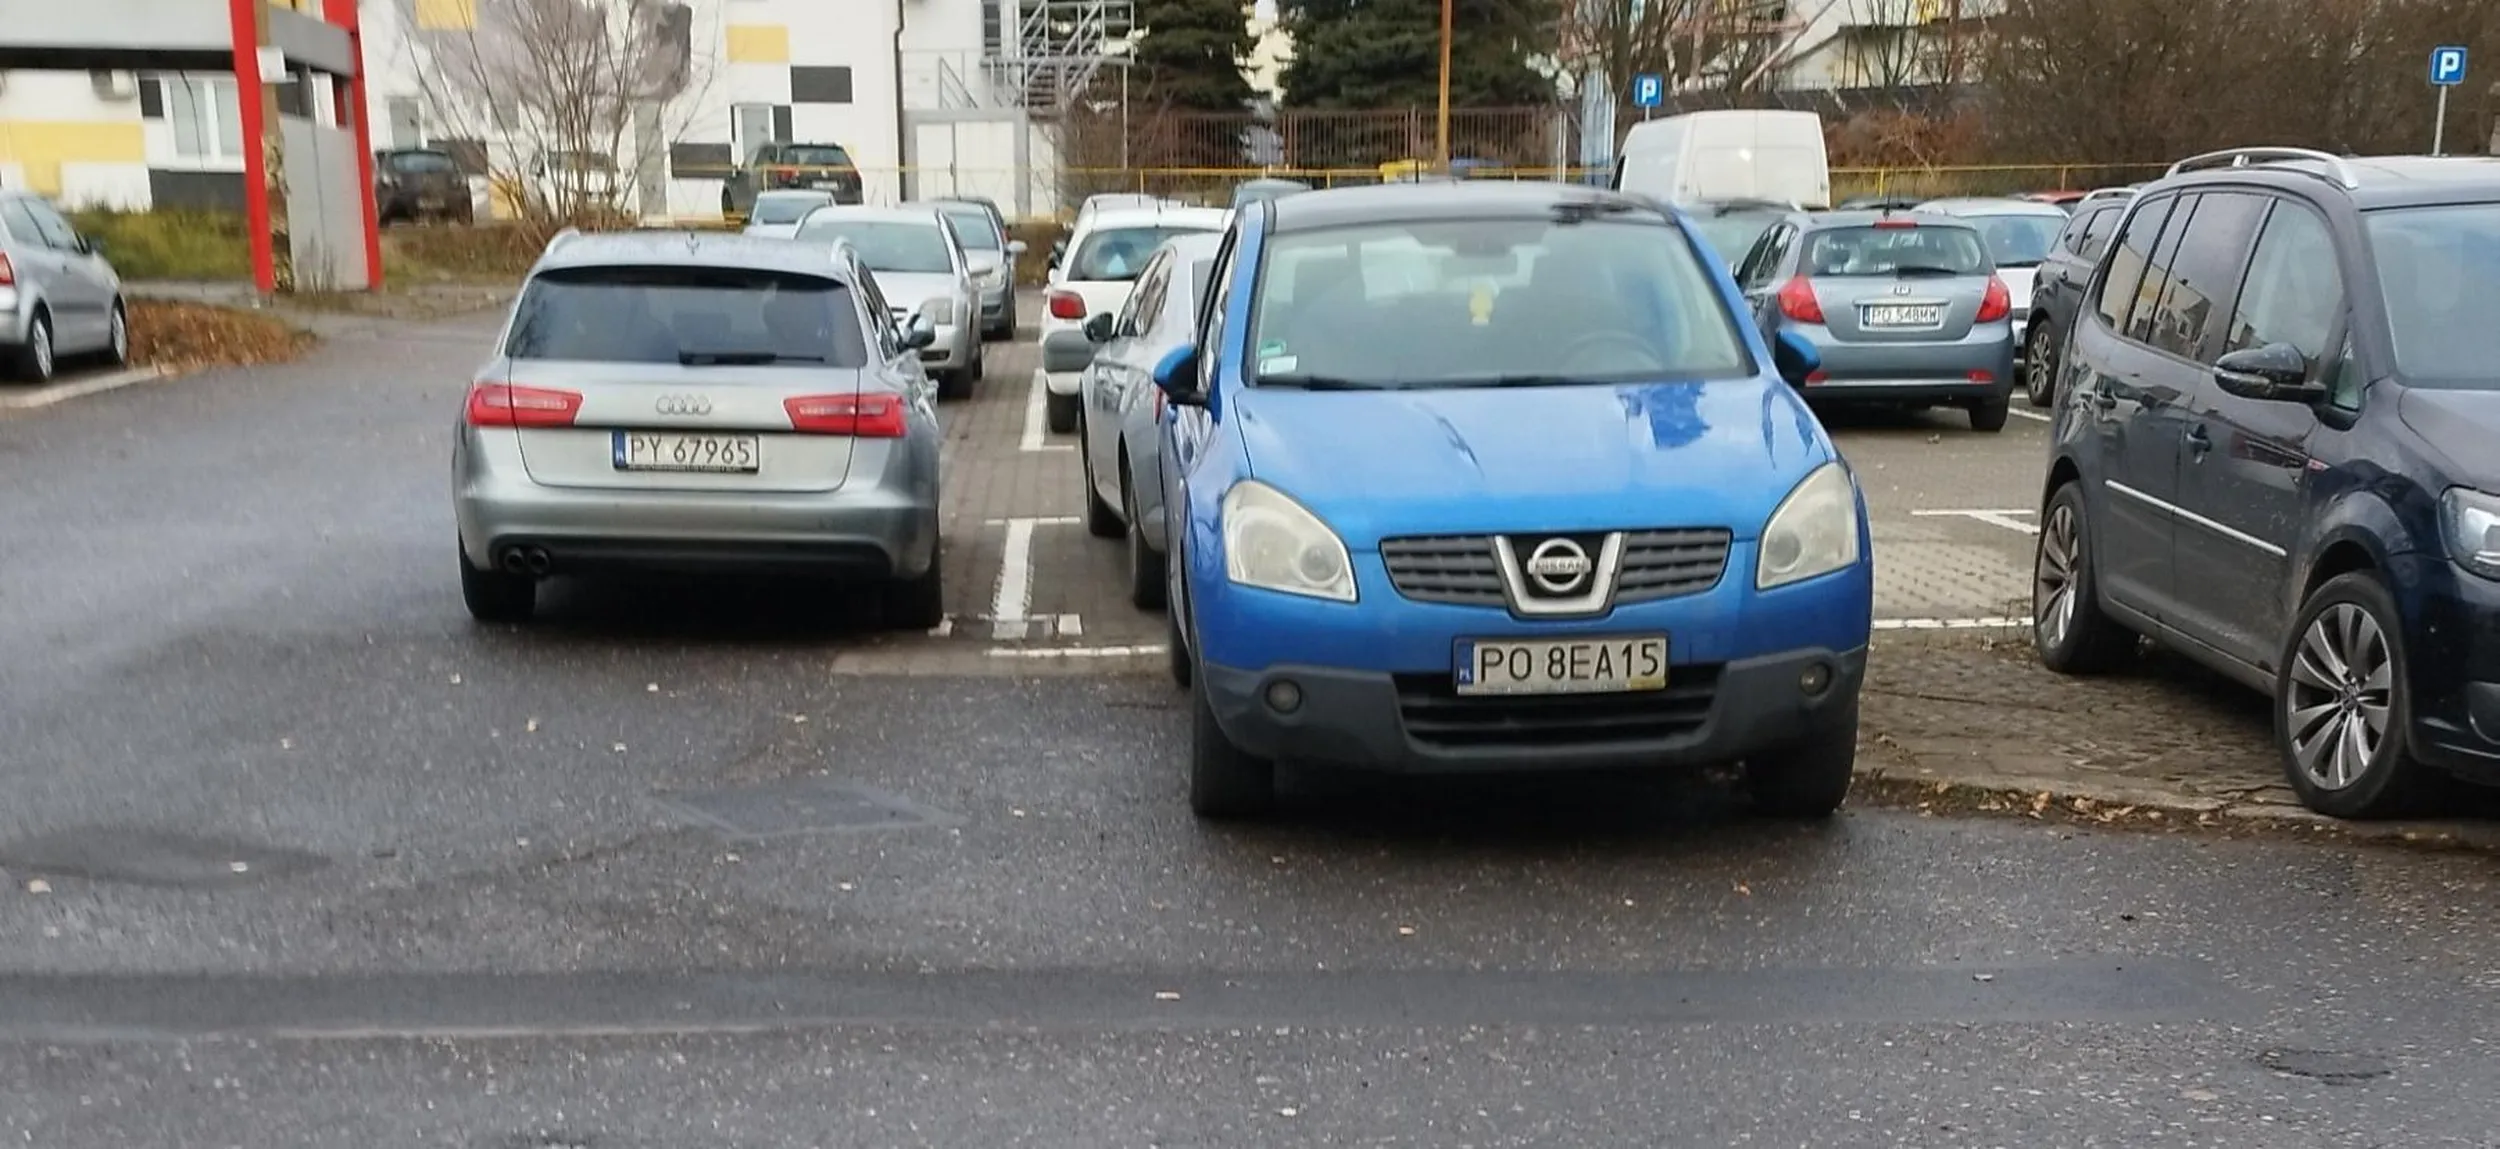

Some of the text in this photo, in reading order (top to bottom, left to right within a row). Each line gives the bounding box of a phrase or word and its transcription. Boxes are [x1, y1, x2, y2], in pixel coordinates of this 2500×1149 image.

[2439, 51, 2460, 80] P
[1641, 78, 1657, 103] P
[630, 433, 751, 465] PY 67965
[1535, 560, 1586, 570] NISSAN
[1480, 643, 1659, 683] PO 8EA15
